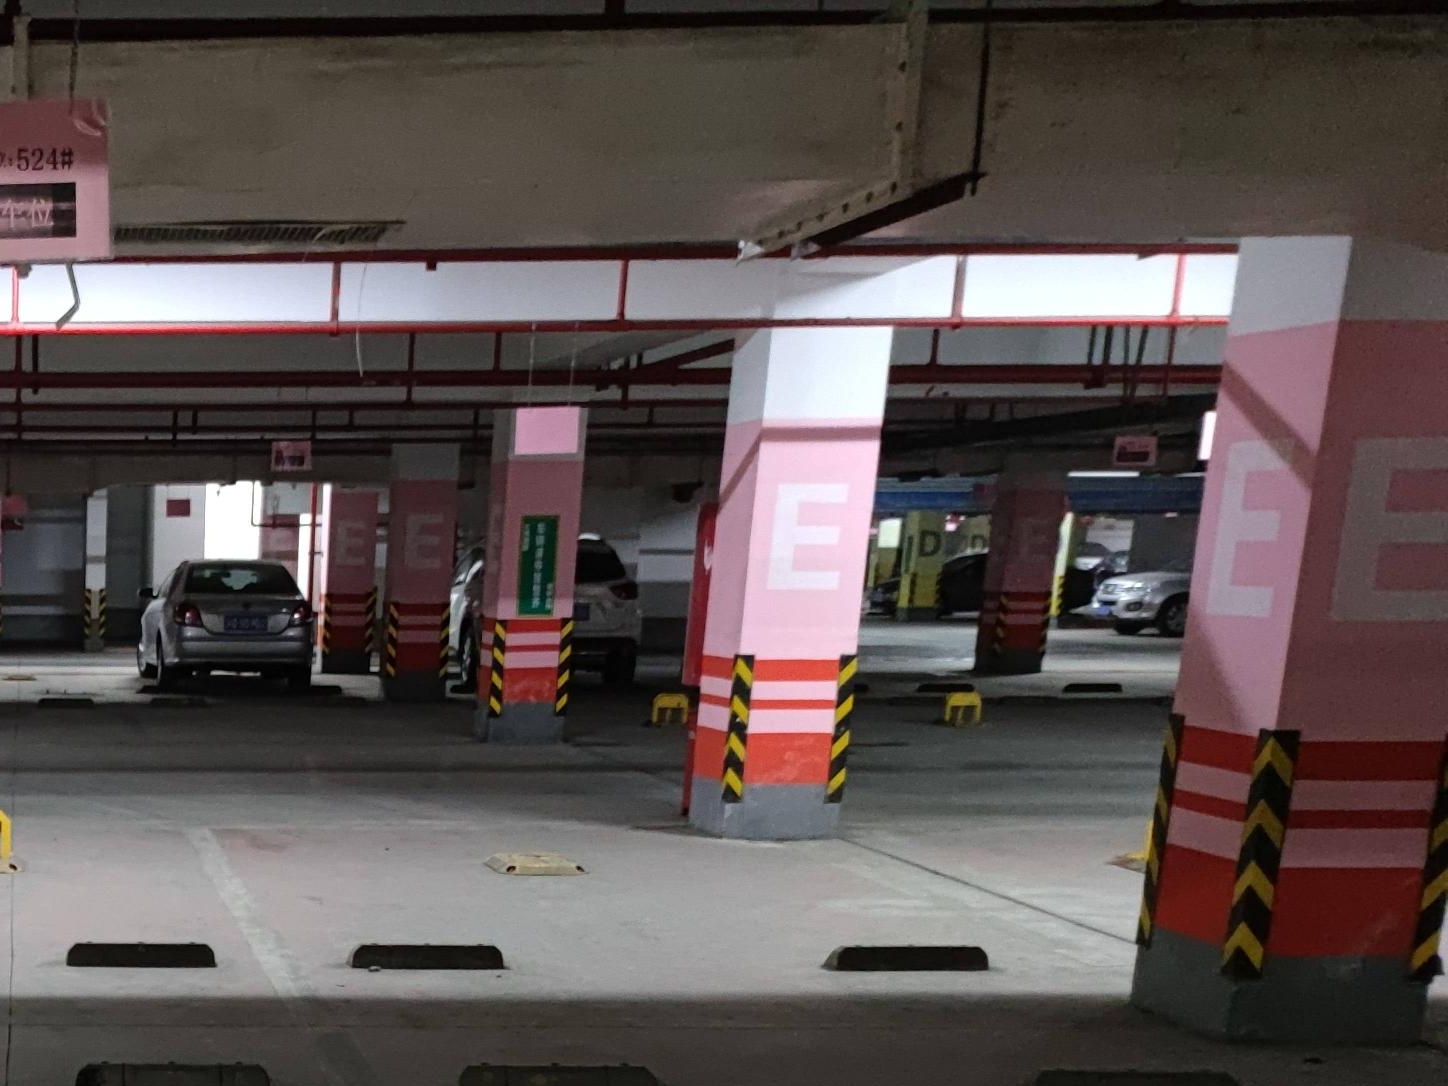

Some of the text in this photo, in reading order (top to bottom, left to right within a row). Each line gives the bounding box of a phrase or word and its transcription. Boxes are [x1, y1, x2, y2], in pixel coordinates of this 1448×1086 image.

[404, 513, 444, 569] E
[766, 483, 848, 590] E
[919, 529, 942, 557] D
[1206, 438, 1296, 618] E
[1331, 437, 1448, 621] E
